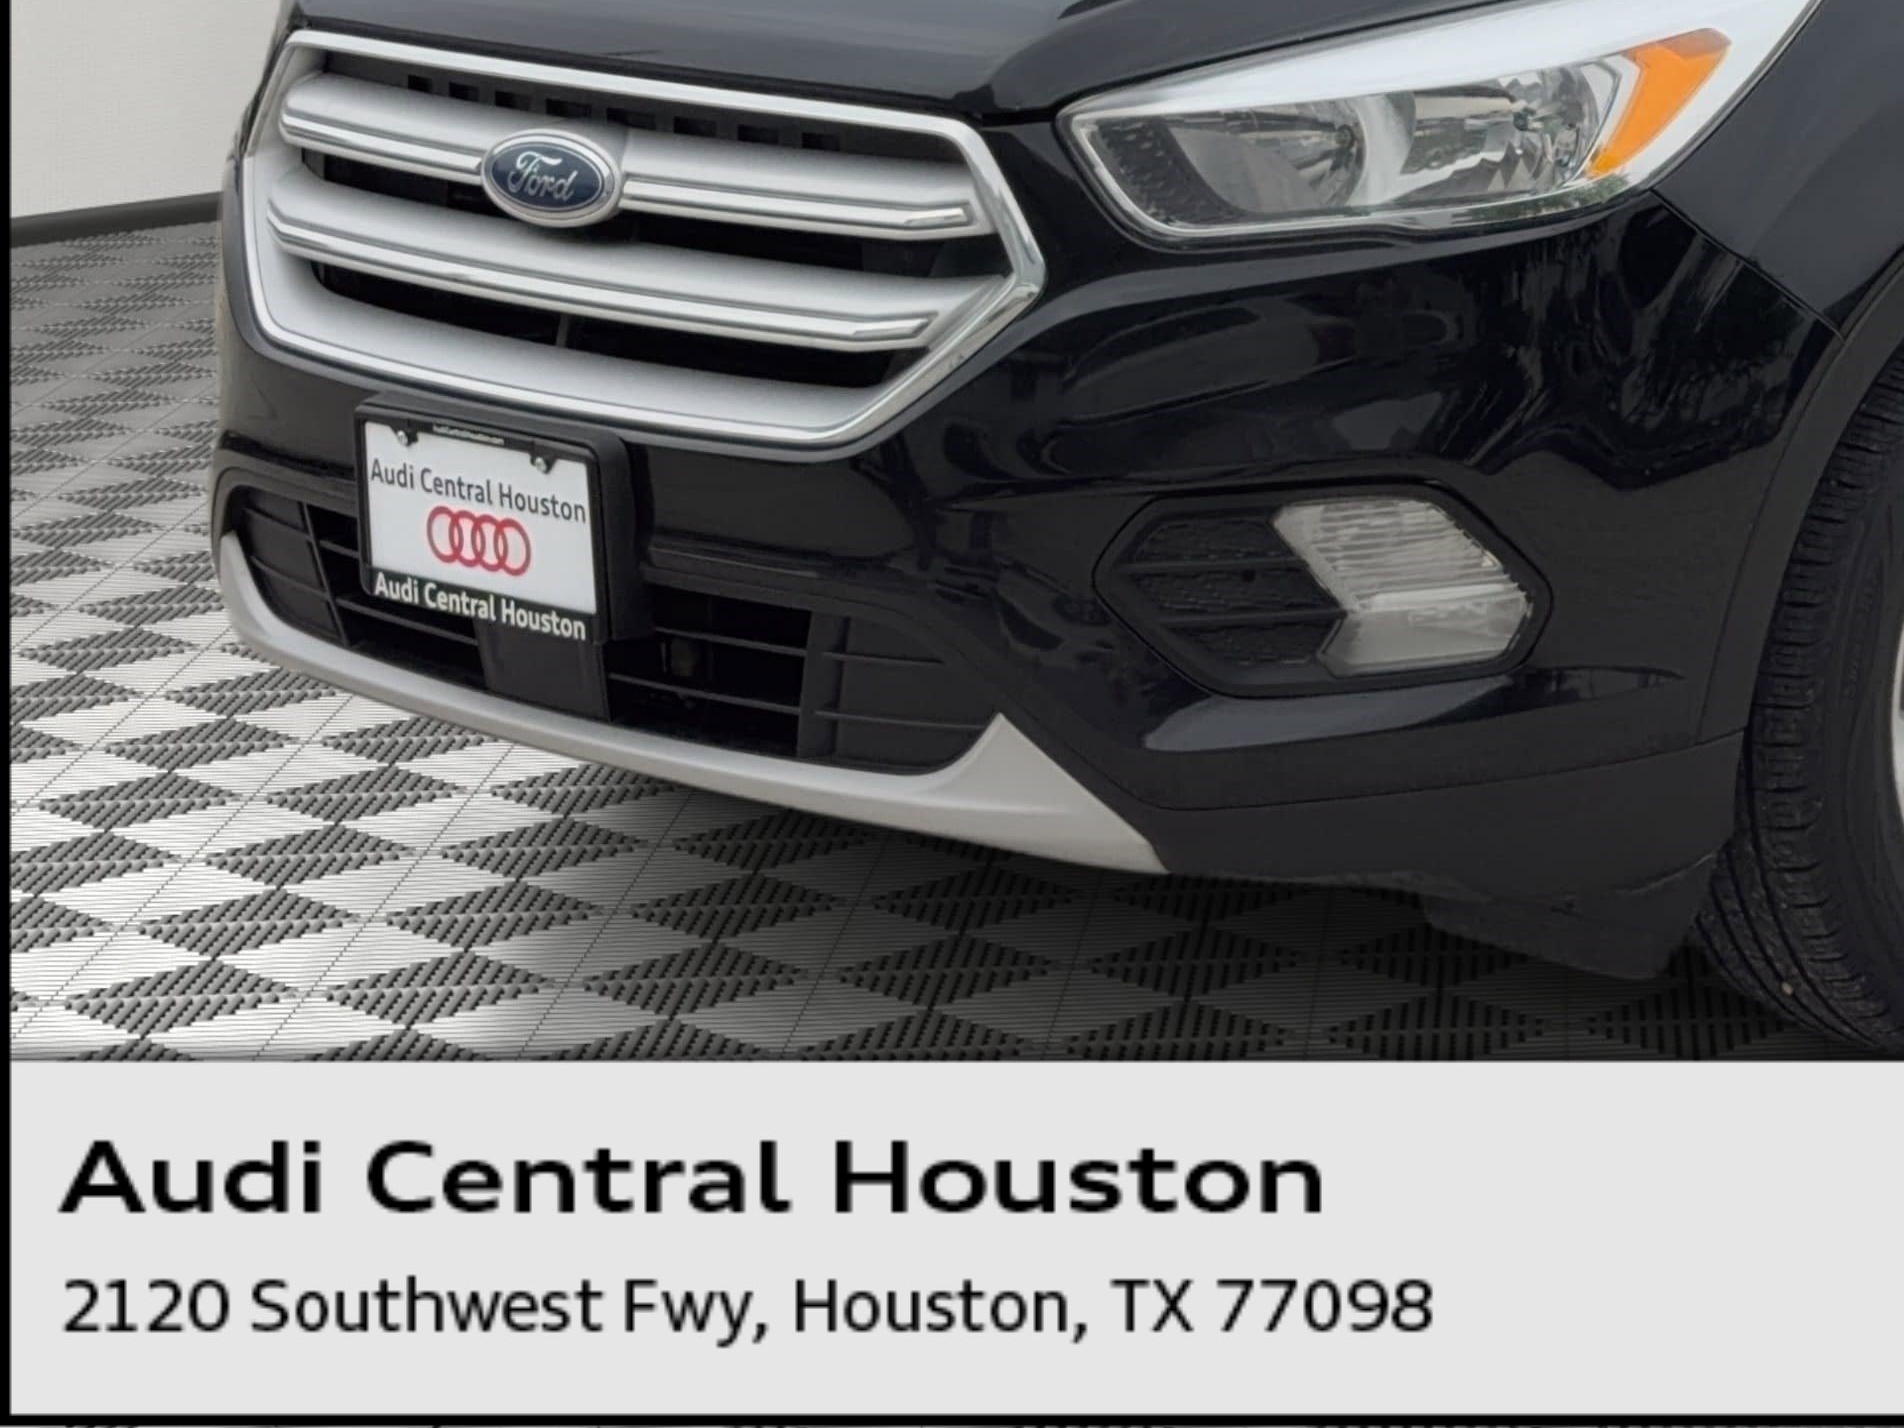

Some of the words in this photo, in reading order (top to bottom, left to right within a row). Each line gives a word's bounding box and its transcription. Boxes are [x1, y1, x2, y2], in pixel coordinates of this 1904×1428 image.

[507, 150, 579, 202] Ford
[370, 457, 415, 490] Audi
[420, 471, 493, 506] Central
[498, 482, 587, 524] Houston
[373, 571, 419, 605] Audi
[424, 585, 497, 622] Central
[501, 598, 587, 641] Houston
